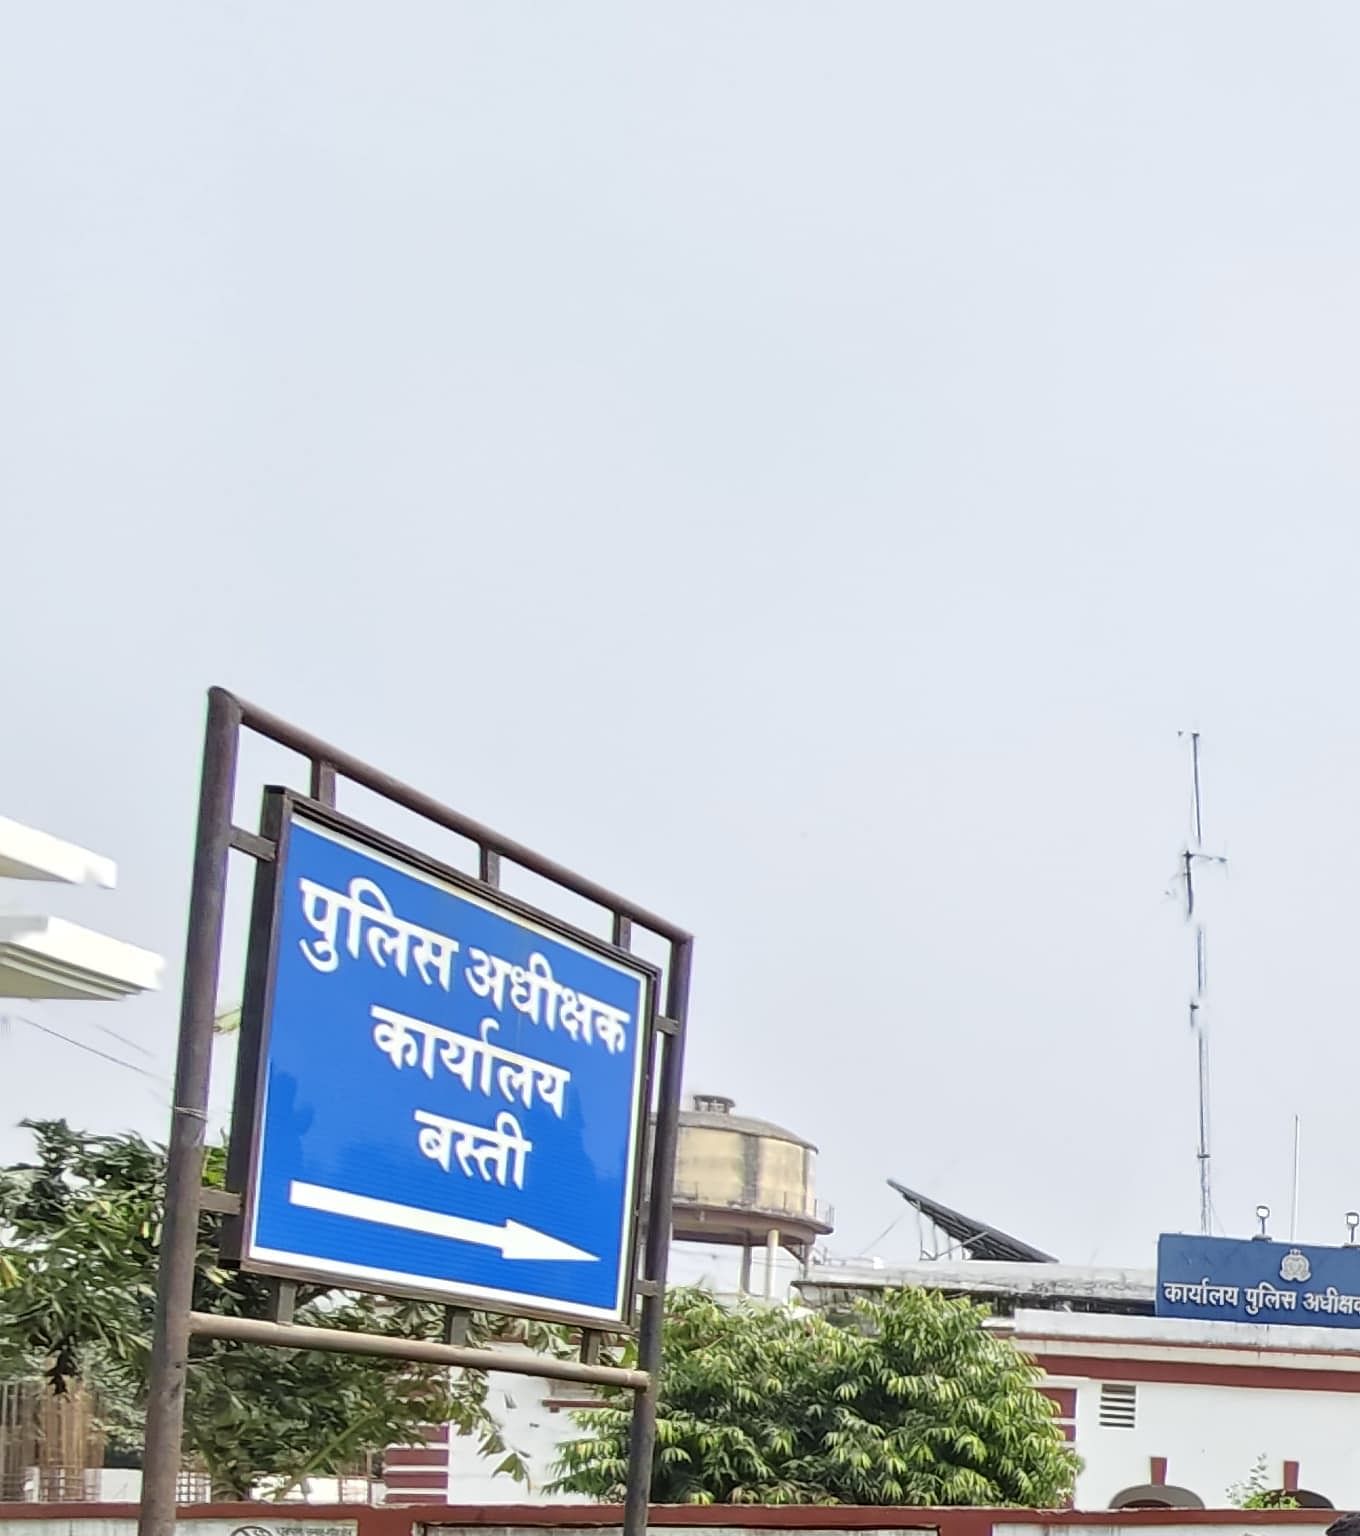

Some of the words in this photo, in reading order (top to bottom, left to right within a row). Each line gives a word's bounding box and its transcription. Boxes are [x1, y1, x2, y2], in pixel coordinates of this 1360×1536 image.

[299, 877, 459, 992] पुलिस
[465, 947, 631, 1055] अधीक्षक
[370, 1004, 571, 1119] कार्यालय
[413, 1109, 532, 1191] बस्ती
[1163, 1277, 1239, 1306] कार्यालय
[1245, 1281, 1297, 1314] पुलिस
